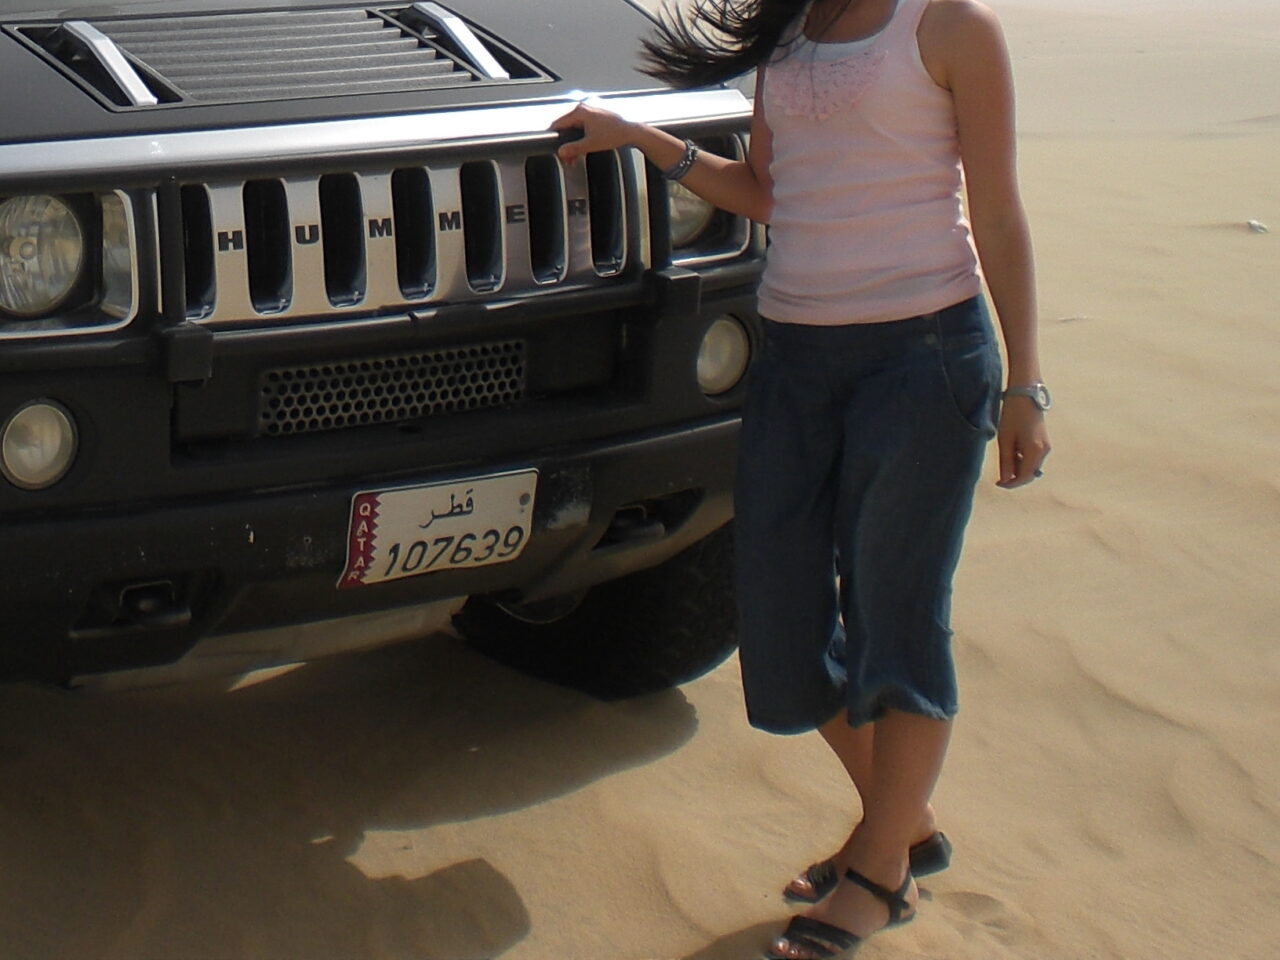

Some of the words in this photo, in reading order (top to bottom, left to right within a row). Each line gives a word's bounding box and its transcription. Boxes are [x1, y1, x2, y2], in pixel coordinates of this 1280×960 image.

[218, 198, 587, 252] HUMMER
[419, 489, 474, 529] قطر
[347, 502, 371, 581] QATAR
[383, 525, 525, 577] 107639
